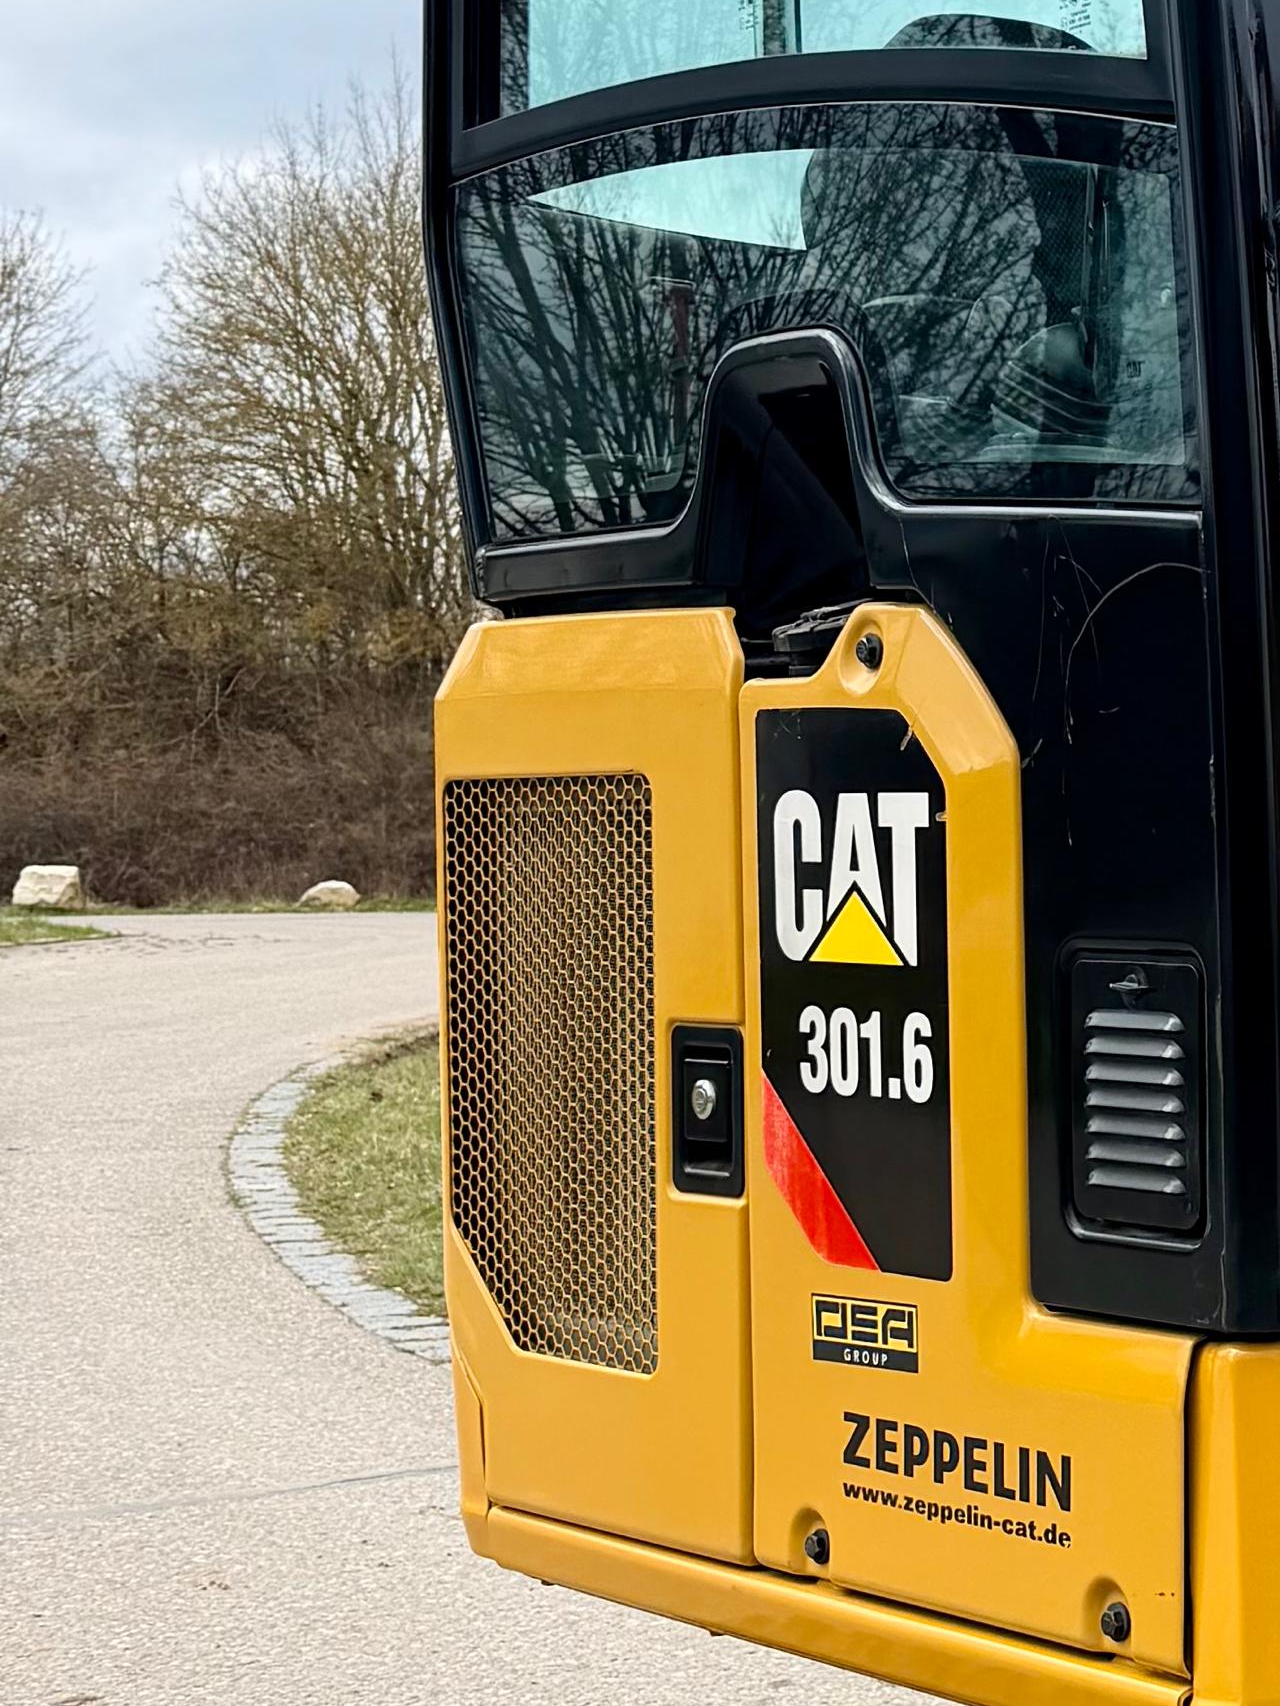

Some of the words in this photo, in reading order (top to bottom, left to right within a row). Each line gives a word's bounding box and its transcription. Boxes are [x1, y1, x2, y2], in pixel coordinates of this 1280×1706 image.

[773, 790, 930, 967] CAT
[799, 1005, 934, 1104] 301.6
[843, 1348, 889, 1366] GROUP
[842, 1411, 1072, 1512] ZEPPELIN
[842, 1482, 1072, 1549] www.zeppelin-cat.de
